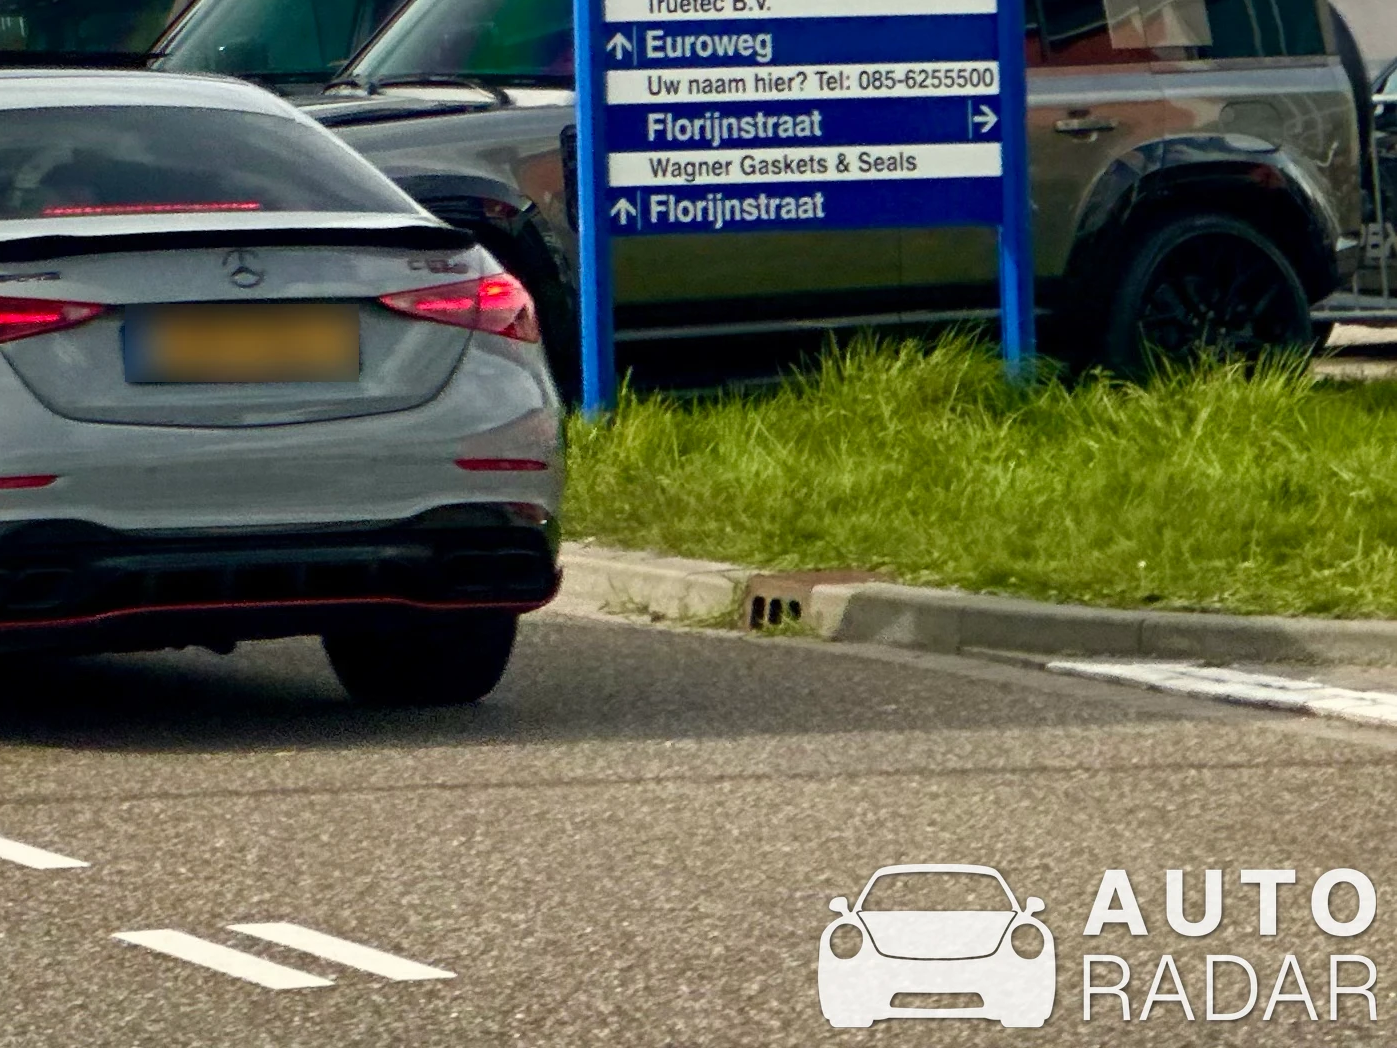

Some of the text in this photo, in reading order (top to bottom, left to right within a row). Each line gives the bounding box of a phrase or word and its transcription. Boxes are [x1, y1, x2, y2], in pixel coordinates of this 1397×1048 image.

[646, 29, 773, 63] Euroweg
[647, 67, 995, 96] Uw naam hier? Tel: 085-6255500
[647, 109, 822, 147] Florijnstraat
[649, 151, 918, 182] Wagner Gaskets & Seals
[649, 192, 825, 229] Florijnstraat
